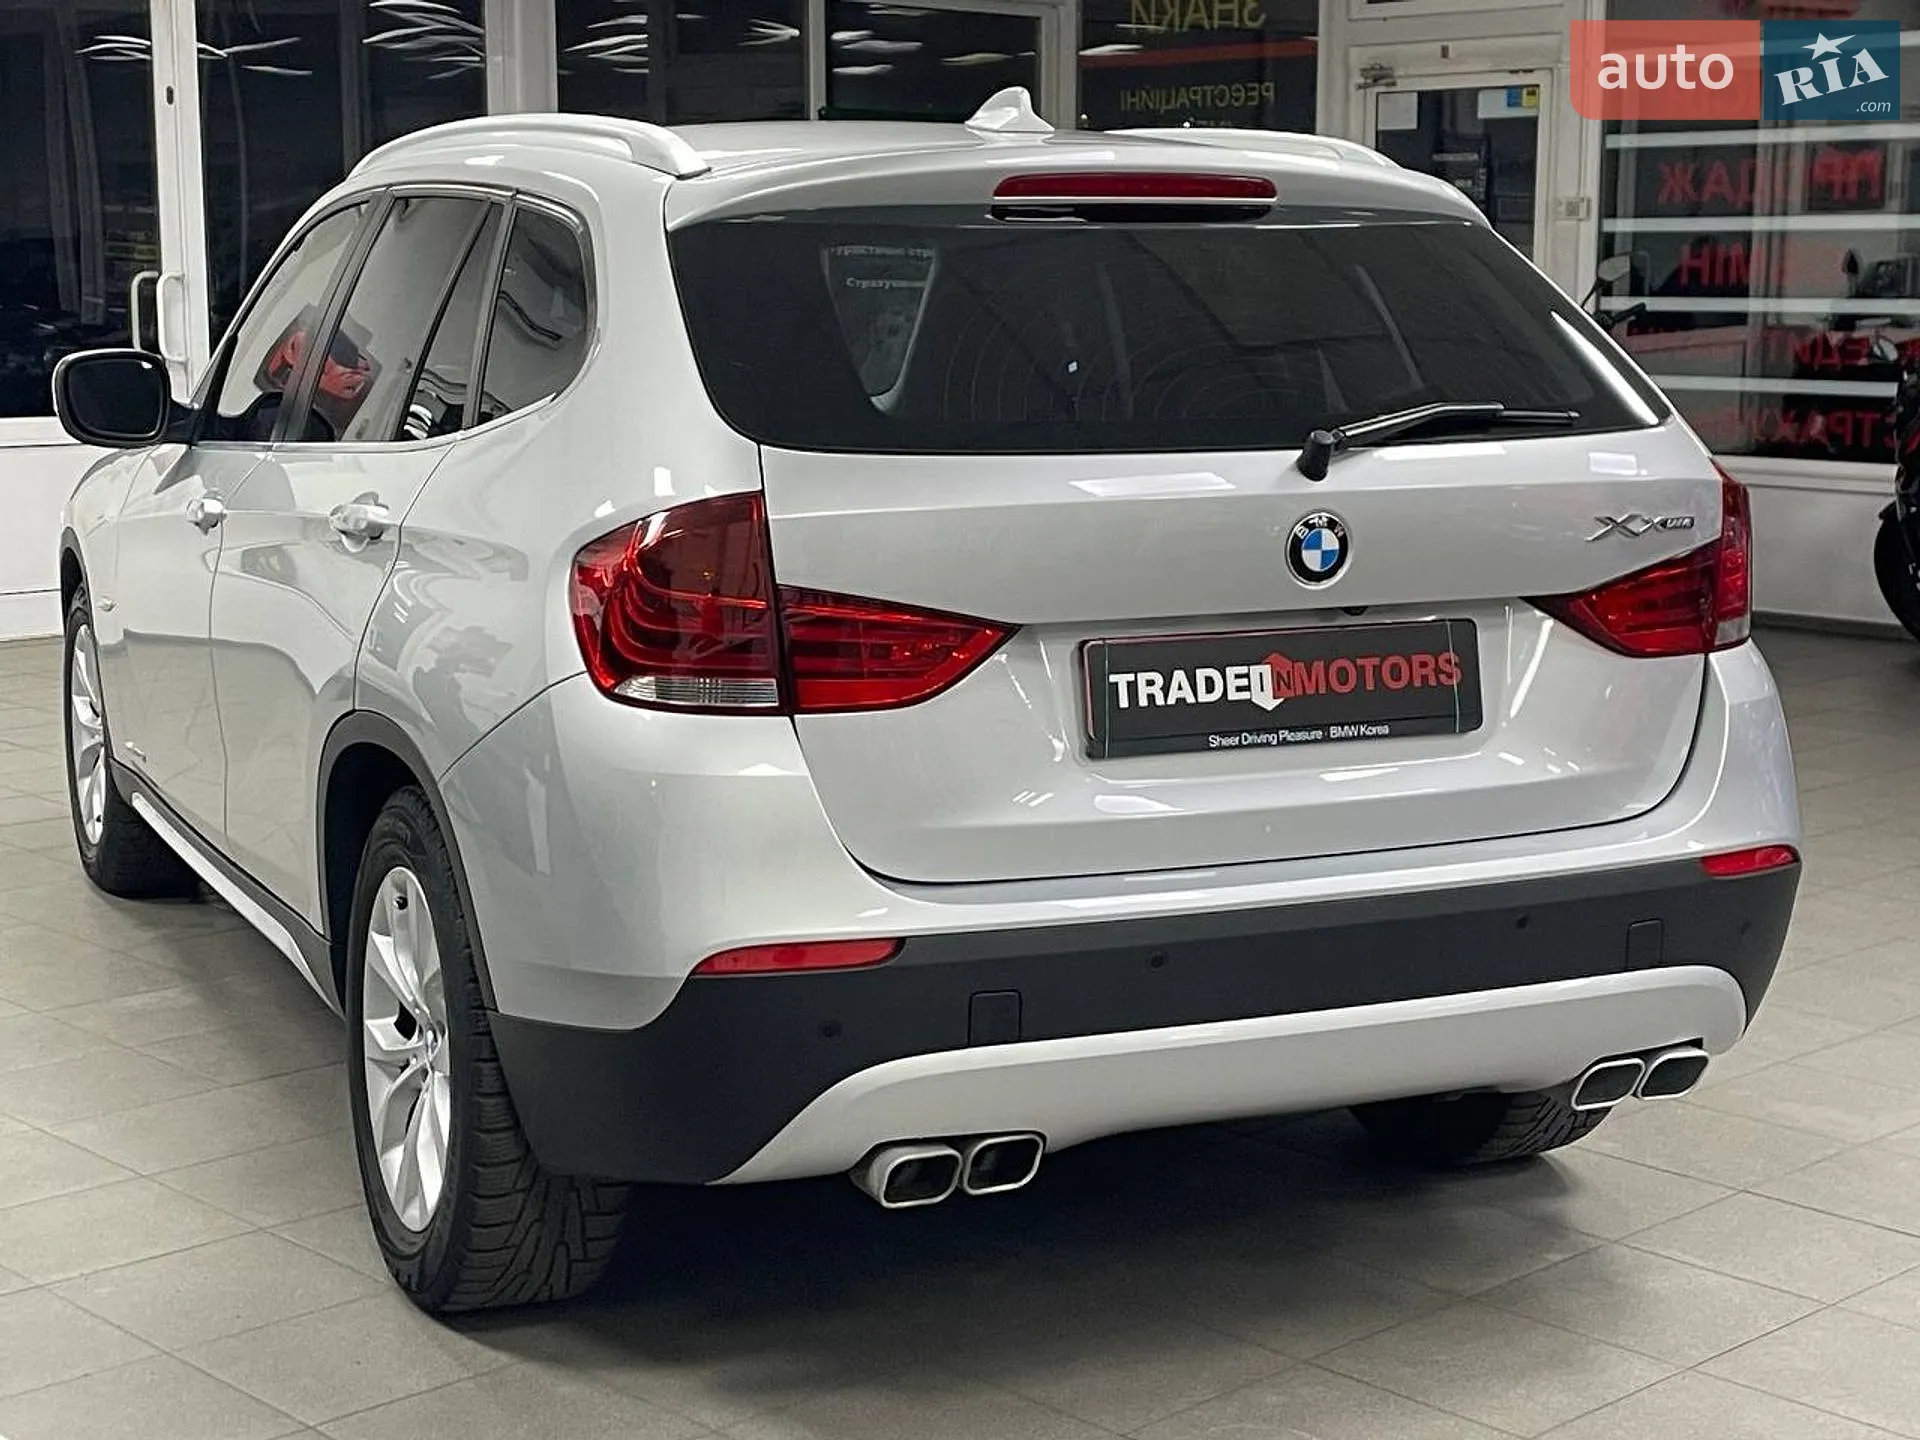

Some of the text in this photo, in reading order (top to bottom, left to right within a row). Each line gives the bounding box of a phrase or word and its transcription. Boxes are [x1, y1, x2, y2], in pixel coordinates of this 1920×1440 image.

[1208, 723, 1390, 748] Sheer Driving Pleasure BMW Korea
